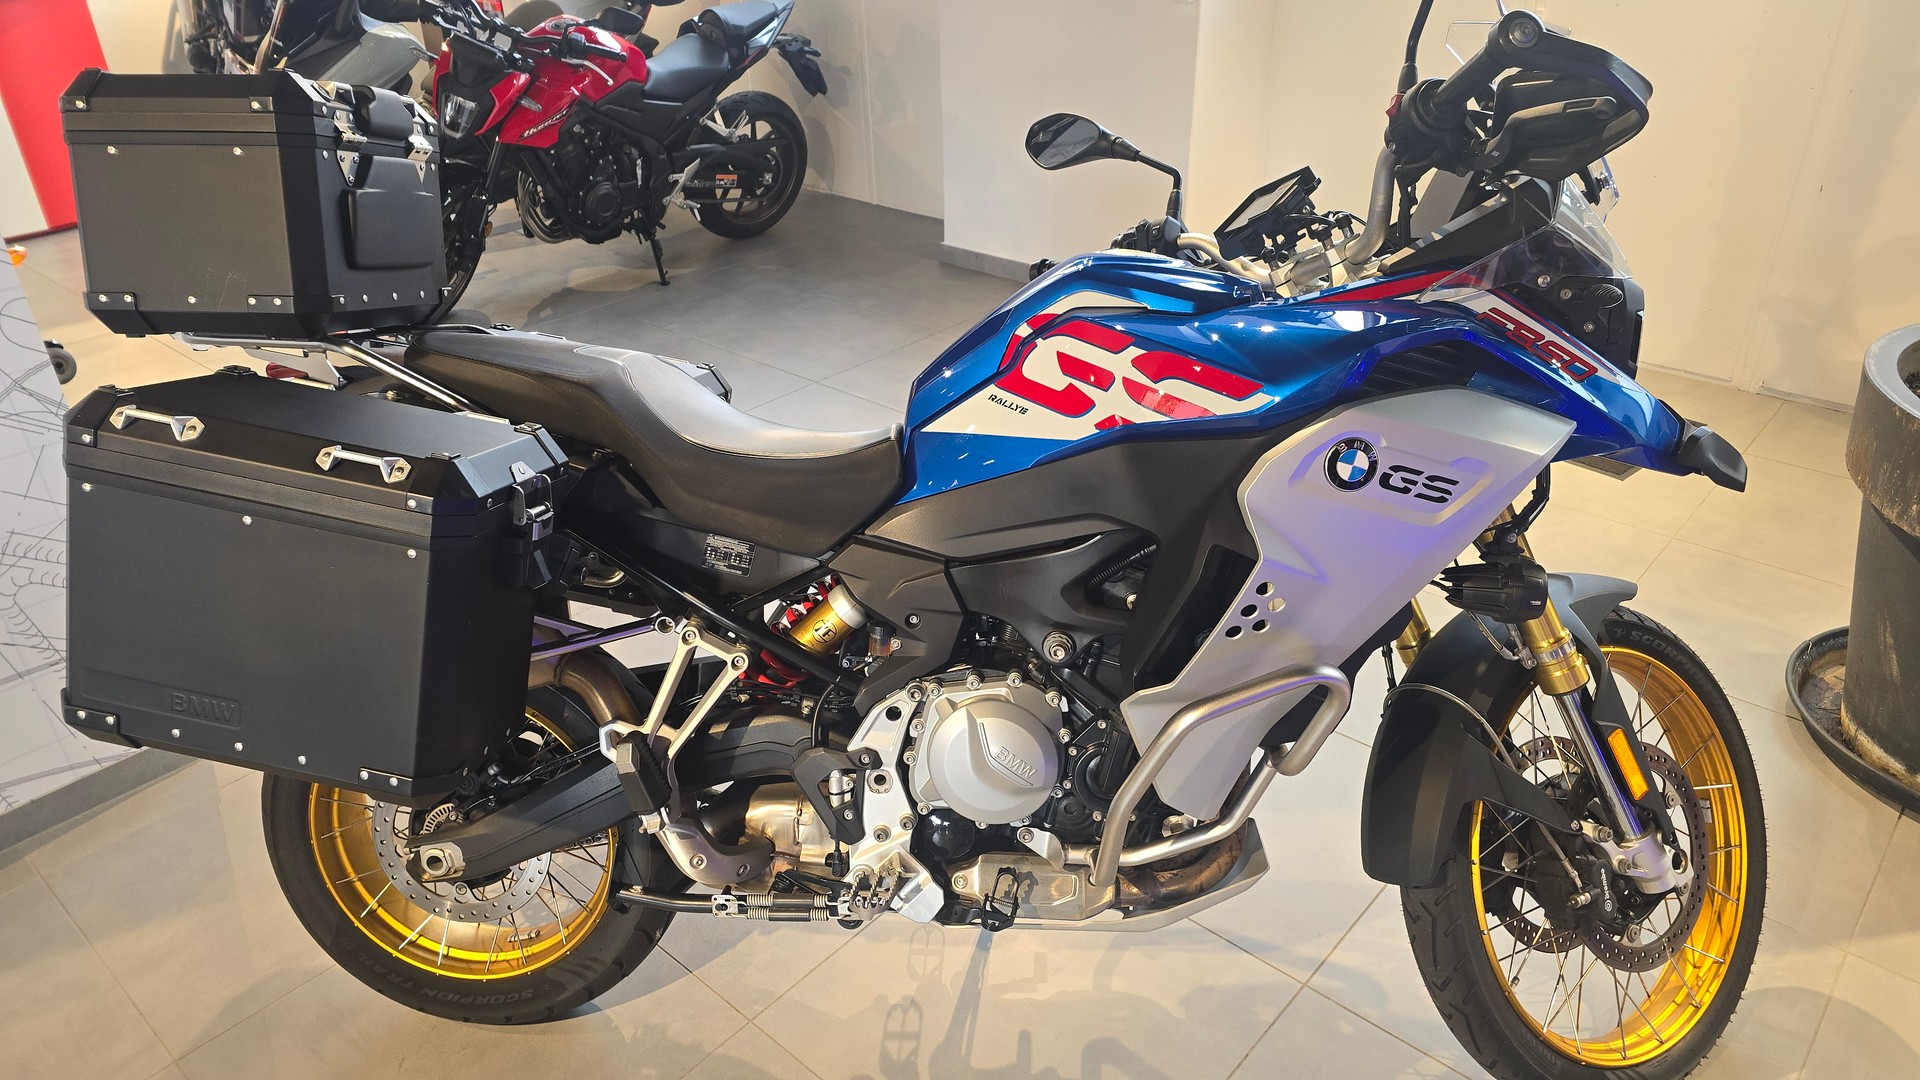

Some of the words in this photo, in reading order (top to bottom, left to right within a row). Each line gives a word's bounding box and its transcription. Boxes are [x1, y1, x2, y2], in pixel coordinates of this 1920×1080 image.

[995, 313, 1265, 431] GS
[988, 393, 1029, 415] RALLYE
[1379, 464, 1461, 504] GS
[171, 691, 237, 723] BMW
[995, 745, 1039, 780] BMW
[1600, 868, 1610, 900] brembo
[421, 987, 534, 1005] SCORPION
